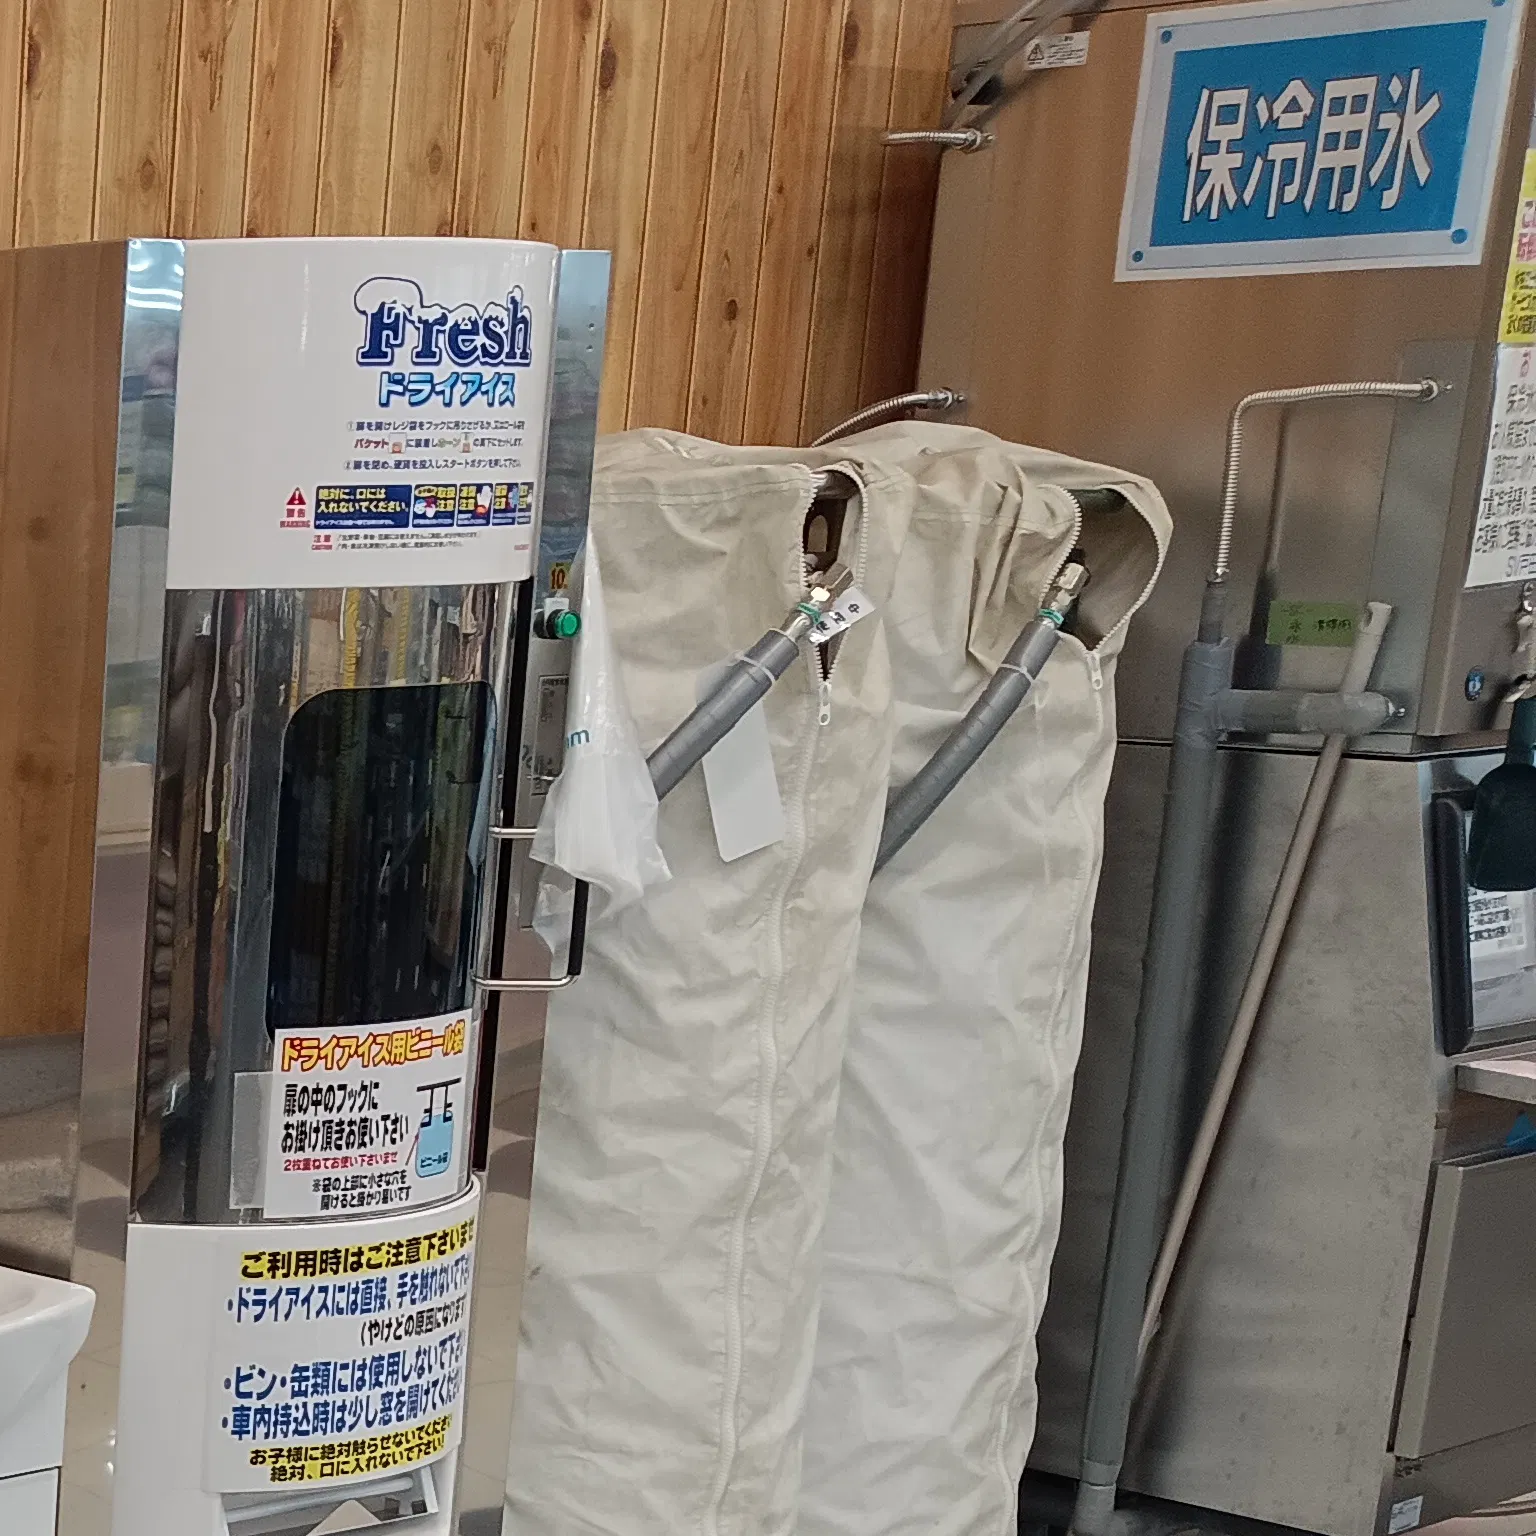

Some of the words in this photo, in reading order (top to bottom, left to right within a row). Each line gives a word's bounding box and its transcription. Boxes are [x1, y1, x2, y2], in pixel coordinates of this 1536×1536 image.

[1181, 68, 1443, 223] 保冷用氷
[355, 283, 532, 368] Fresh
[378, 371, 517, 407] ドライアイス
[281, 1018, 466, 1072] ドライアイス用ビニール袋
[283, 1079, 380, 1117] 扉の中のフックに
[281, 1112, 409, 1154] お掛け頂きお使い下さい
